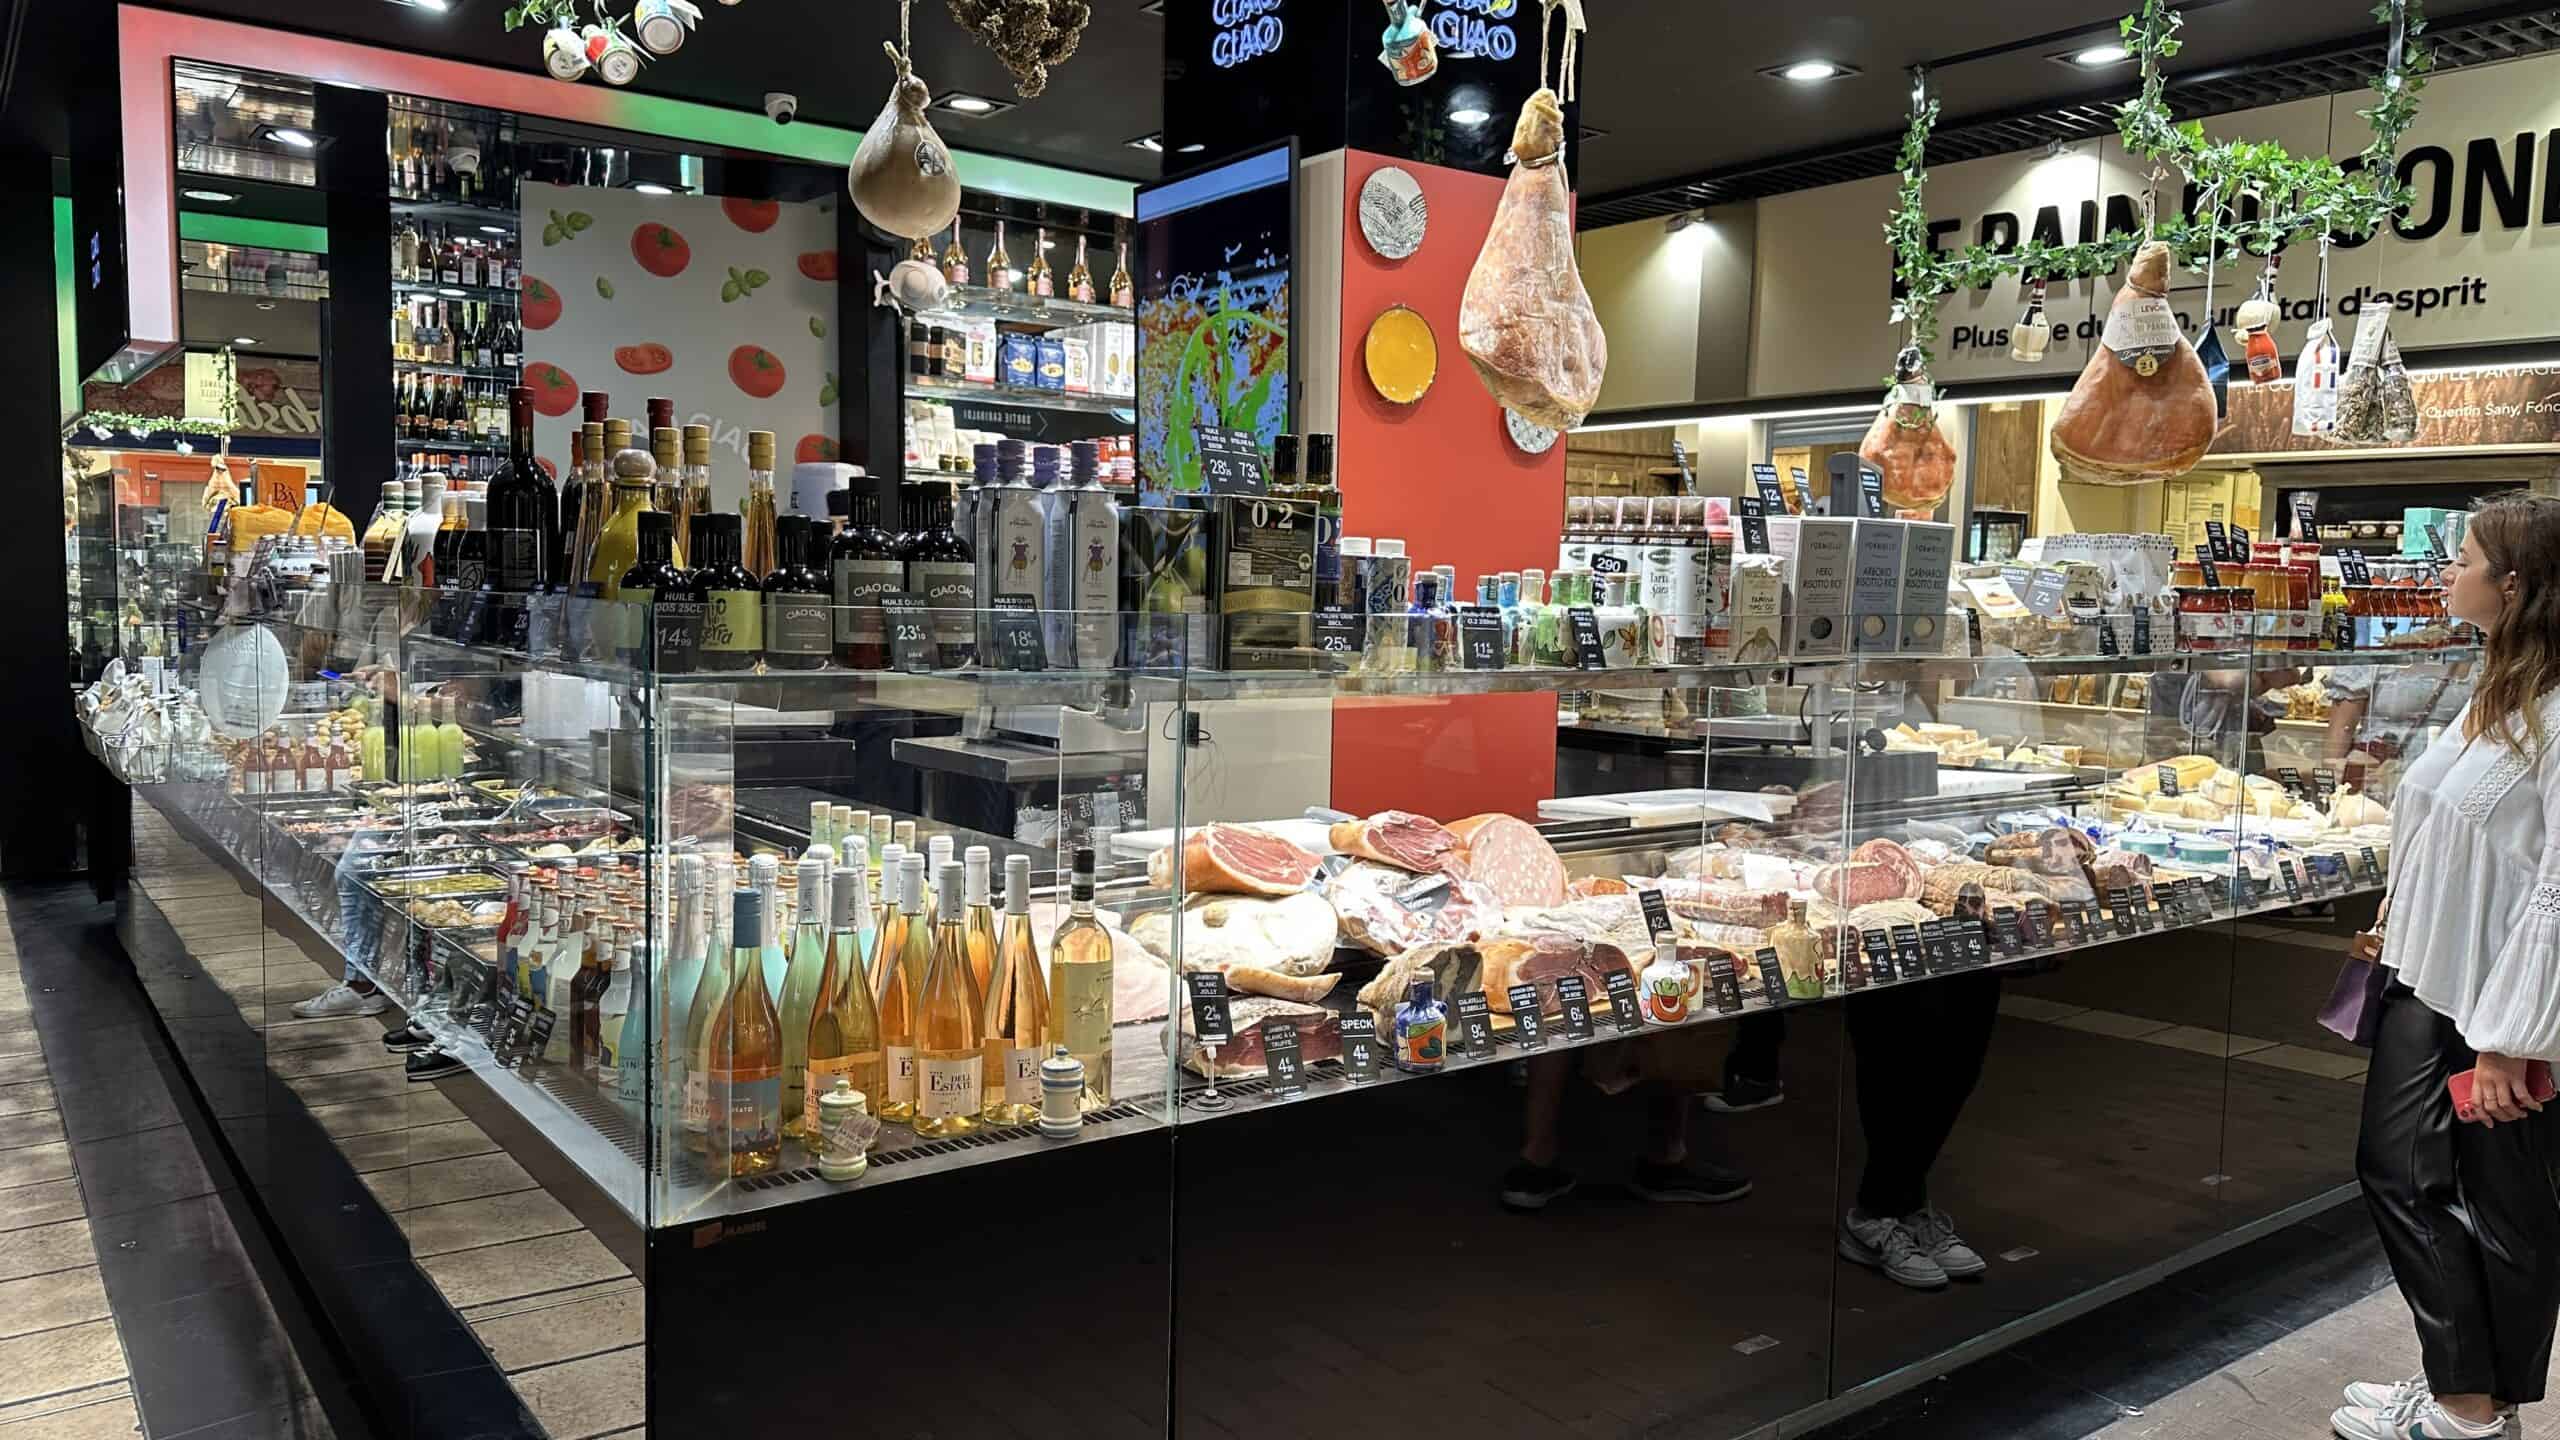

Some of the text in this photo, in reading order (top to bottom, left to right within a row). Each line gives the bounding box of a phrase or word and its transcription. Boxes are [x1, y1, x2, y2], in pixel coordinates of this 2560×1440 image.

[1212, 15, 1283, 68] CIAO
[1431, 9, 1517, 61] CIAO
[1953, 322, 2010, 351] Plus
[2280, 294, 2331, 322] tat
[2425, 397, 2560, 419] Quentin Sany, Fonc
[1251, 500, 1294, 529] 0.2
[1596, 557, 1621, 573] 290
[664, 591, 696, 602] HUILE
[853, 583, 881, 598] CIAO
[930, 584, 974, 600] CIAO CIAO
[786, 608, 827, 621] CIAO CIAO
[1340, 1018, 1374, 1030] SPECK
